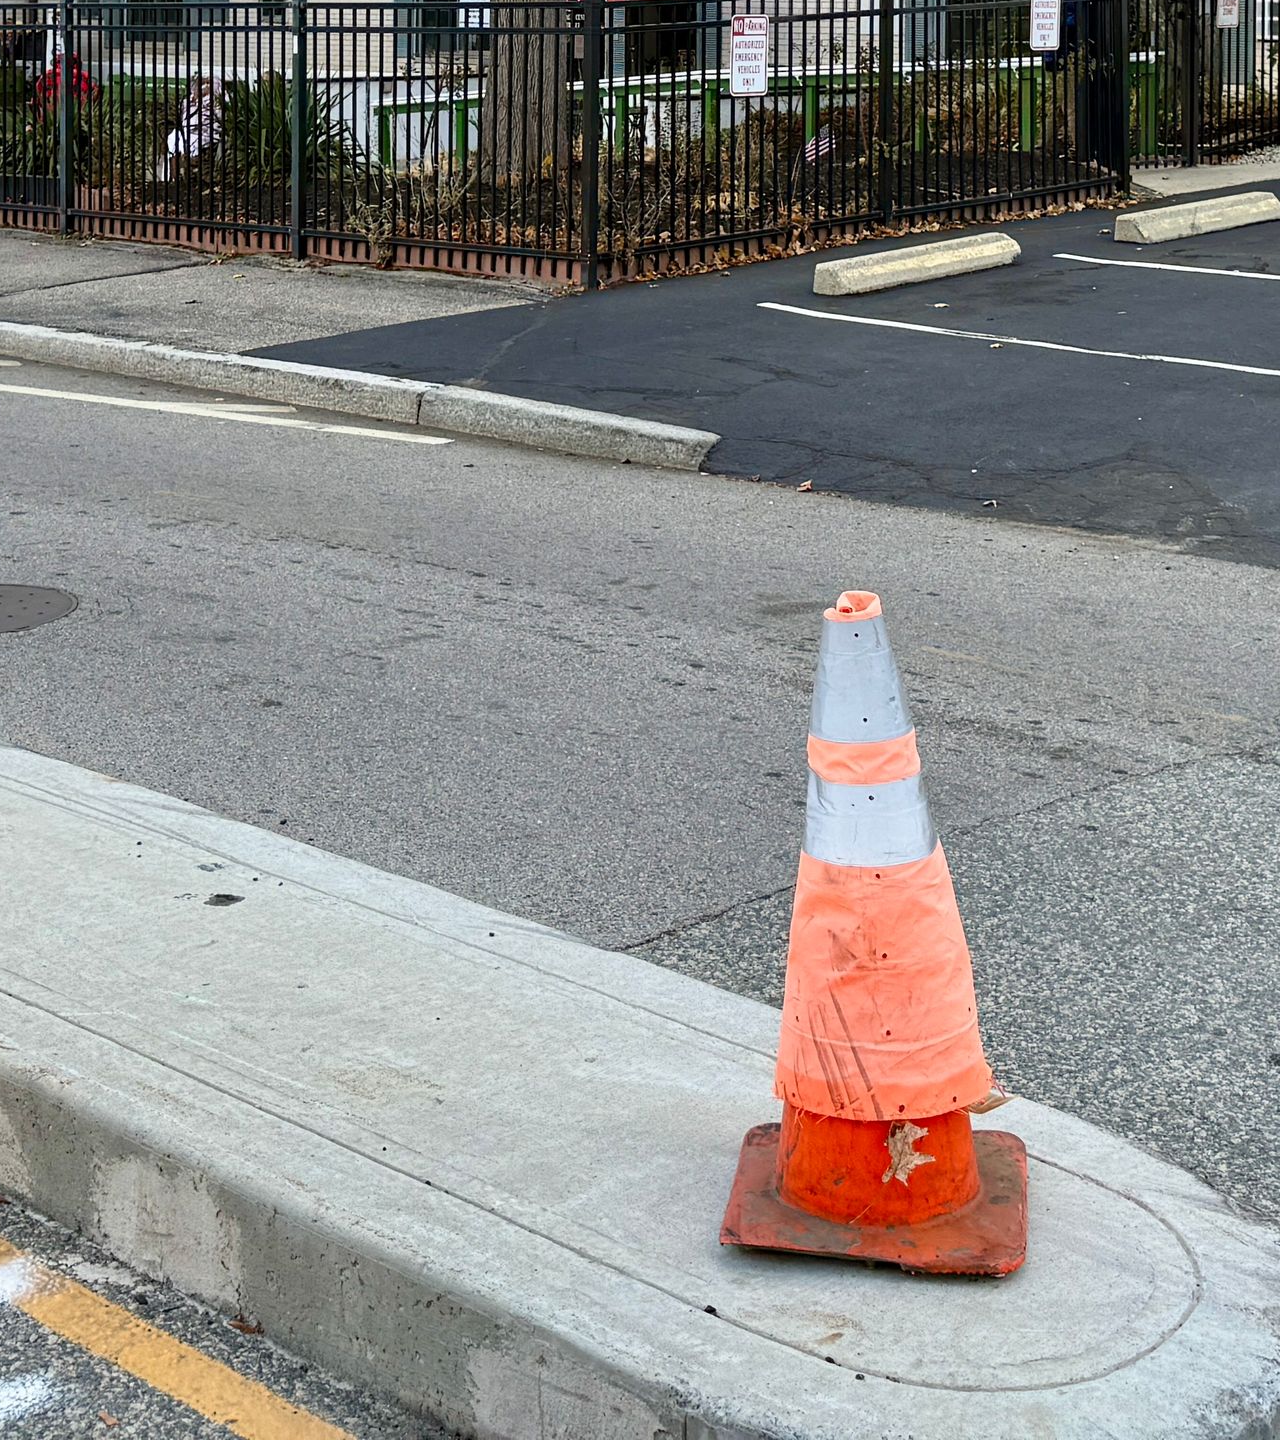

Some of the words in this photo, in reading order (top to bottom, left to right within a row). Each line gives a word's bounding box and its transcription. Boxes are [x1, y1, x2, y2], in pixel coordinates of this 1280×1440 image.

[733, 19, 744, 33] NO
[745, 20, 766, 32] PARKING
[734, 40, 764, 49] AUTHORIZED
[734, 52, 763, 62] EMERGENCY
[737, 65, 761, 74] VEHICLES
[742, 78, 755, 86] ONLY
